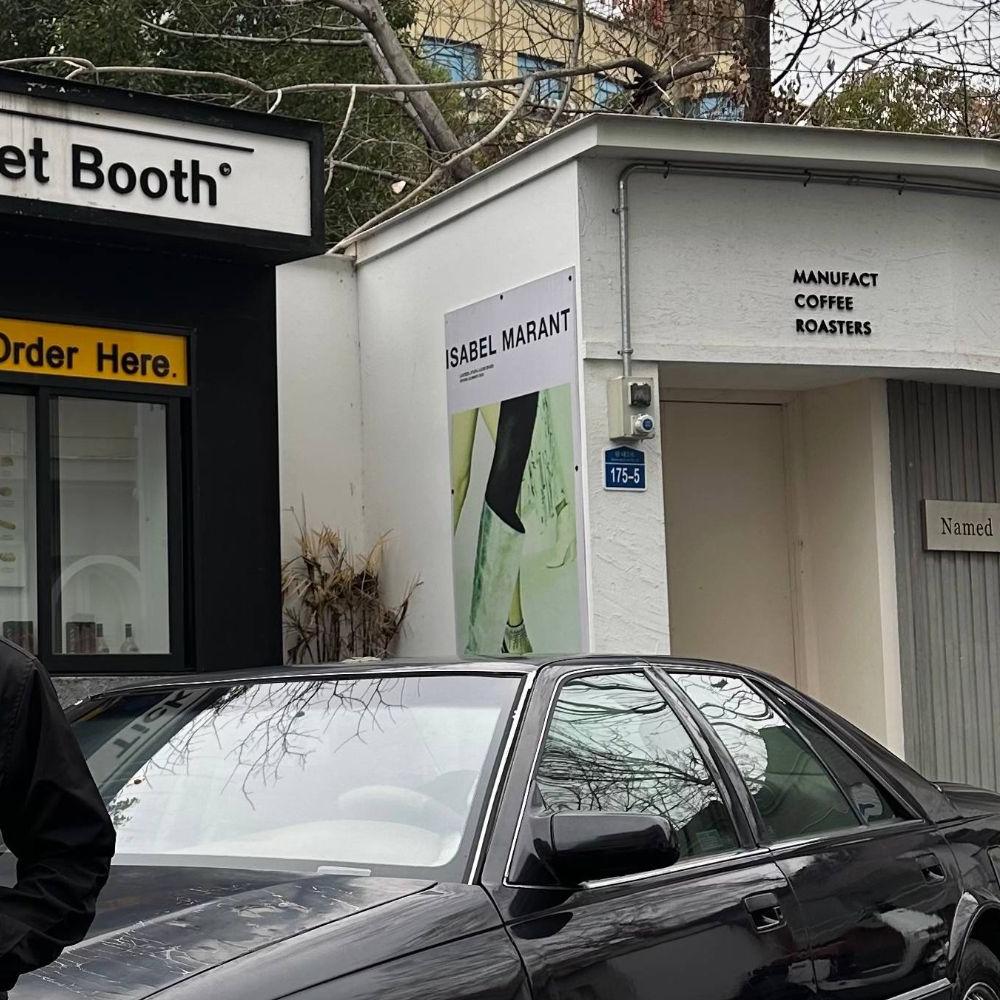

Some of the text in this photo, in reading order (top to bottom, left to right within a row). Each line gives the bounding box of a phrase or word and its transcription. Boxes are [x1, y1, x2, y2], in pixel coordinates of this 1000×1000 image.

[793, 269, 878, 287] MANUFACT
[794, 294, 853, 310] COFFEE
[795, 319, 872, 335] ROASTERS
[445, 308, 570, 369] ISABEL MARANT
[97, 342, 178, 379] Here.
[610, 467, 640, 484] 175-5
[940, 517, 994, 537] Named
